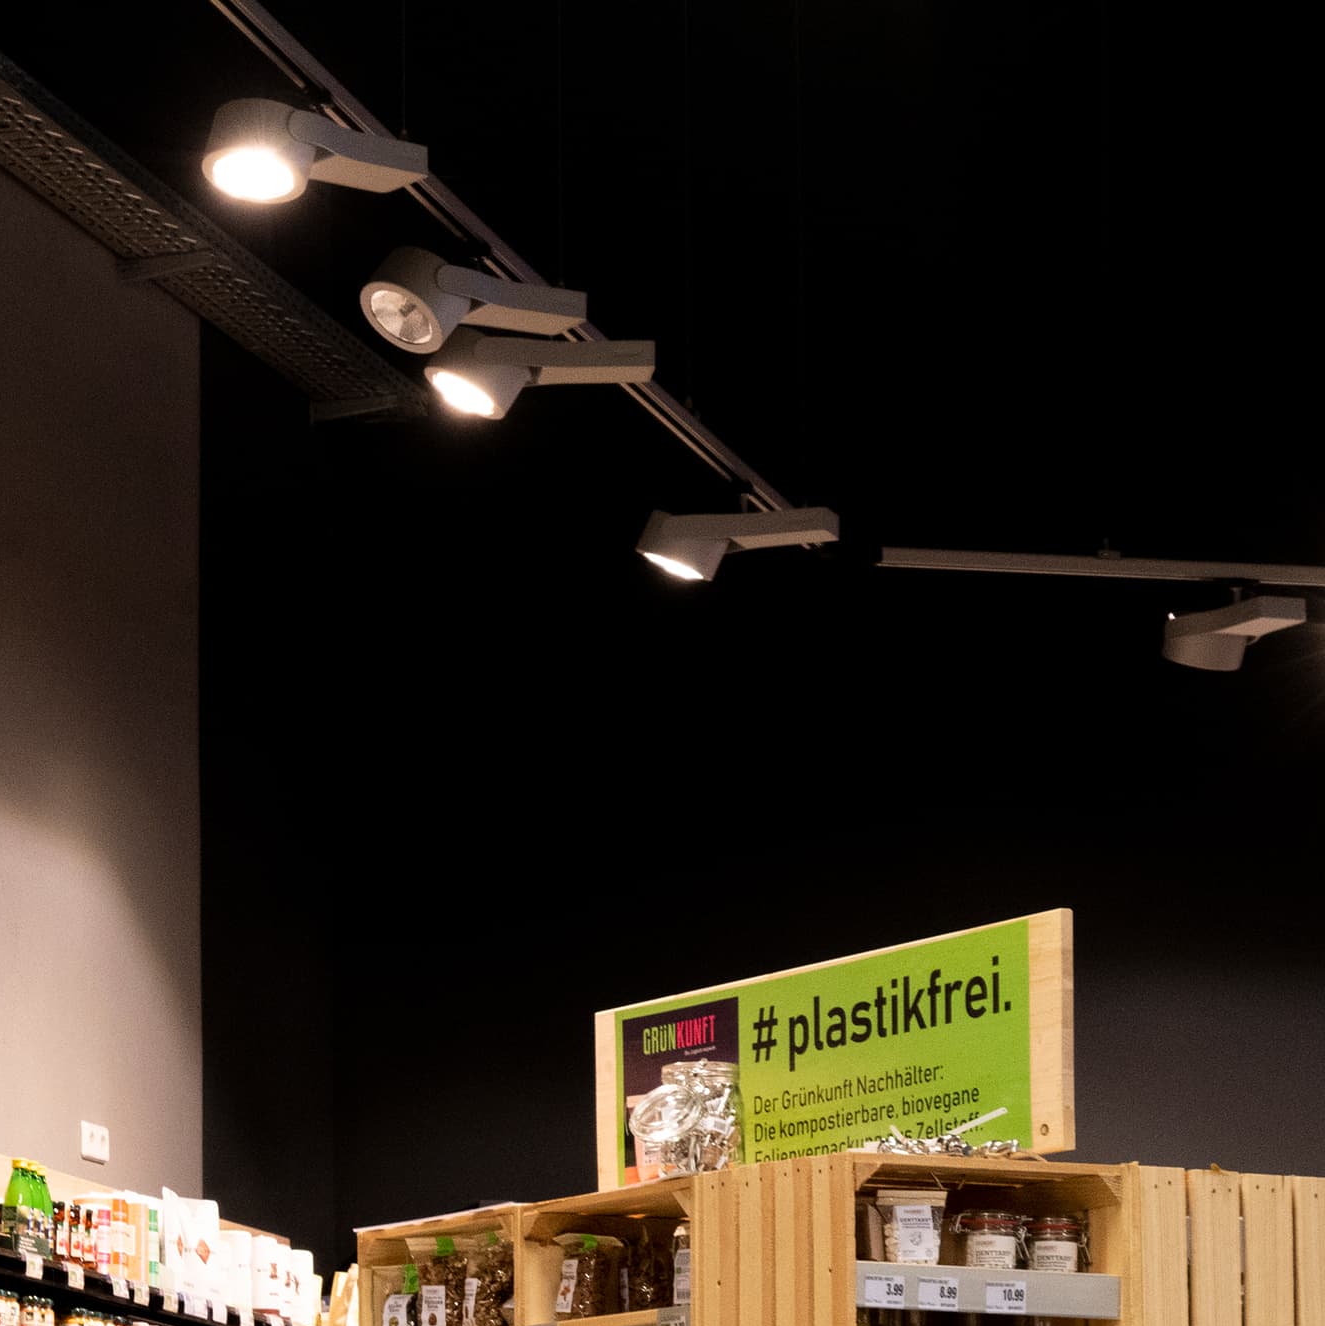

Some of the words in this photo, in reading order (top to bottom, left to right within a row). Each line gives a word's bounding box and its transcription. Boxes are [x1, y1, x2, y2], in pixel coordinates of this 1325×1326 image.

[642, 1014, 716, 1056] GRÜNKUNFT
[754, 1095, 779, 1115] Der
[781, 1080, 853, 1112] Grünkunft
[856, 1064, 944, 1096] Nachhälter:
[755, 1123, 776, 1142] Die
[779, 1106, 899, 1139] kompostierbare,
[902, 1087, 979, 1117] biovegane
[886, 1284, 904, 1296] 3.99
[940, 1287, 957, 1298] 8.99
[1003, 1289, 1024, 1301] 10.99
